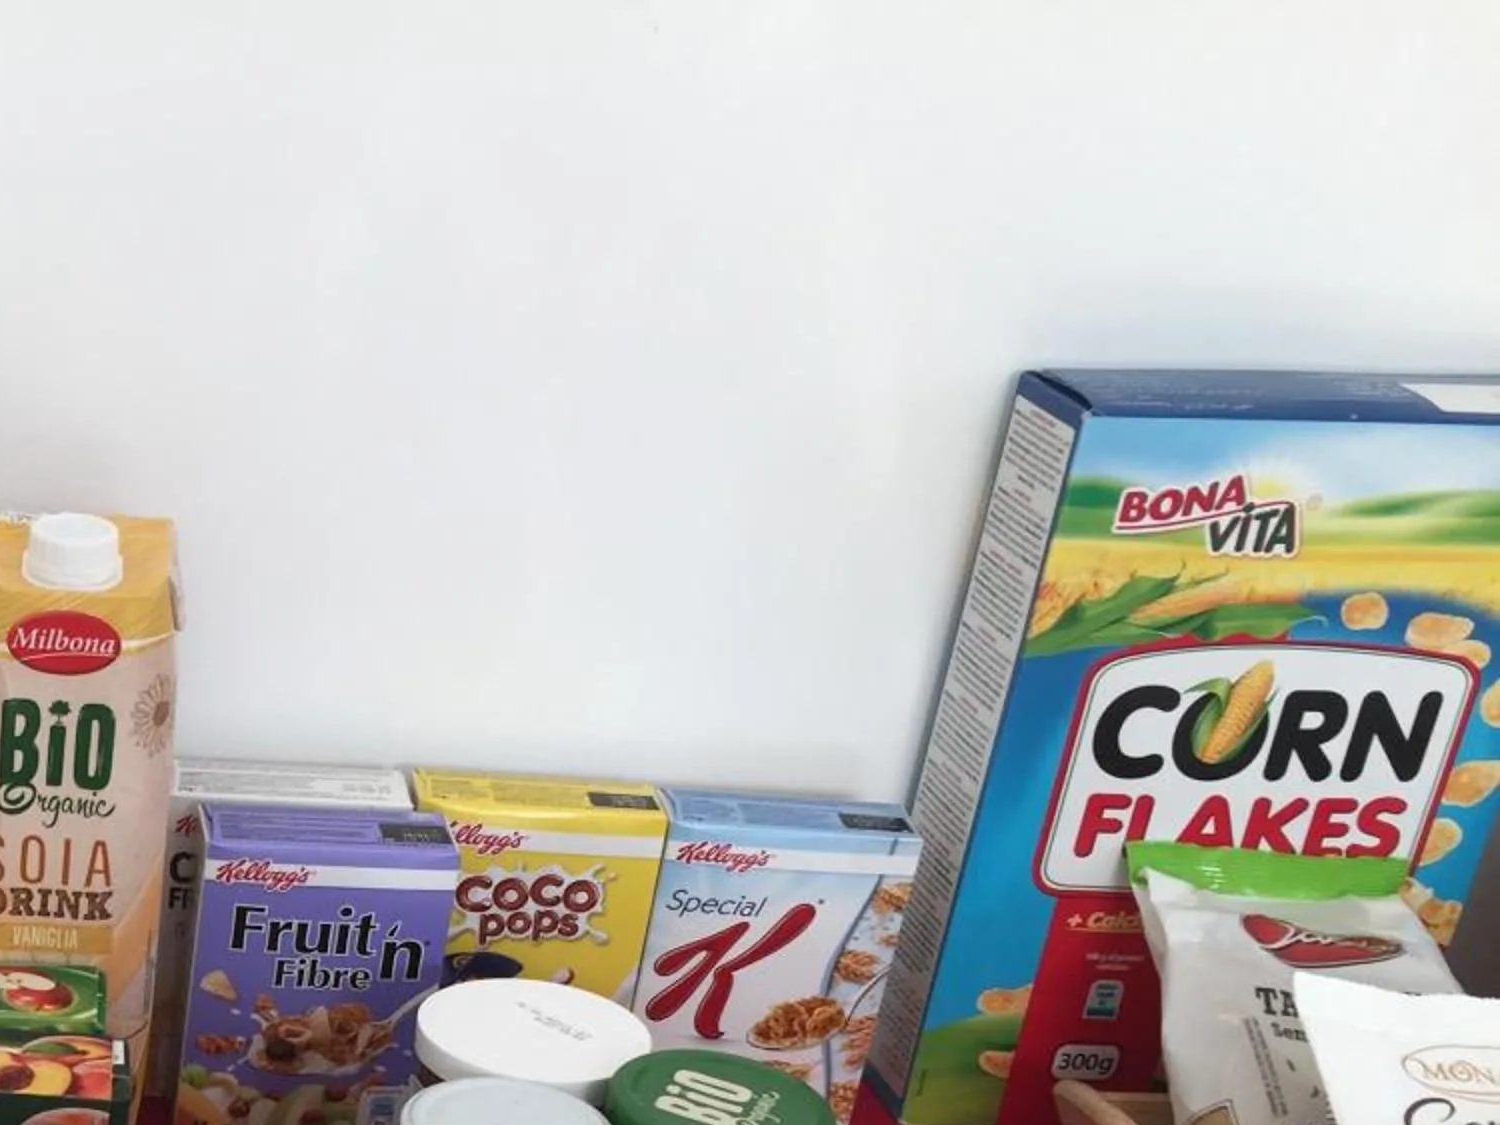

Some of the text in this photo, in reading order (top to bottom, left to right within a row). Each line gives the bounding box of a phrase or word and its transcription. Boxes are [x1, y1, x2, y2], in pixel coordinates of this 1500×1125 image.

[1117, 475, 1247, 525] BONA
[12, 627, 120, 656] Milbona
[1092, 684, 1445, 783] CORN
[677, 841, 772, 872] Kellogg's
[216, 859, 312, 891] Kellogg's
[455, 874, 599, 913] COCO
[665, 889, 768, 918] Special
[12, 925, 80, 951] VANIGLIA
[229, 905, 379, 958] Fruit
[479, 909, 580, 945] pops
[274, 958, 372, 990] Fibre
[645, 903, 816, 1040] K
[1058, 1052, 1114, 1076] 300g
